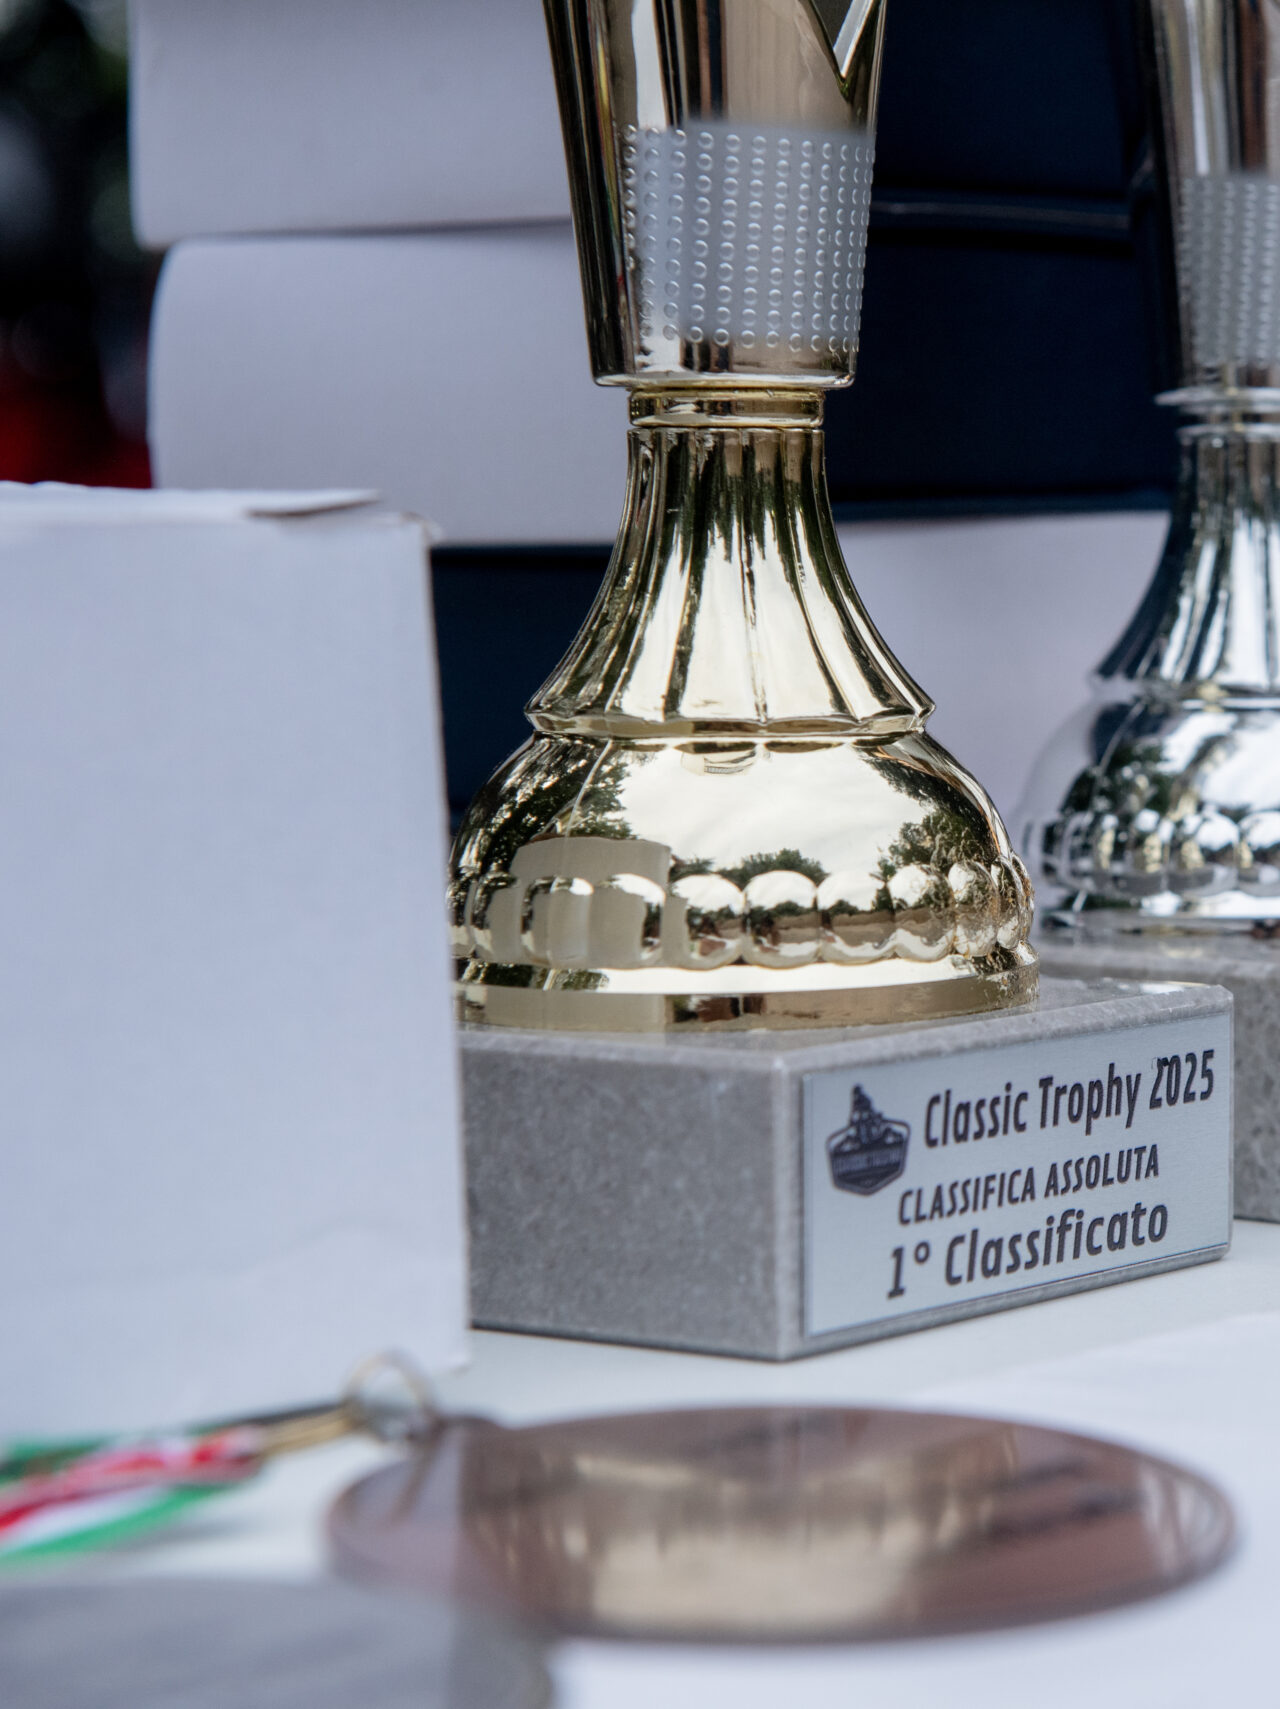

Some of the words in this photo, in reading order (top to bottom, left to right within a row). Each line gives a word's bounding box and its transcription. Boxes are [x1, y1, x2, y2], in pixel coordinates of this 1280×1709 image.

[925, 1082, 1028, 1149] Classic
[1038, 1062, 1142, 1136] Trophy
[1148, 1049, 1216, 1111] 2025
[898, 1166, 1036, 1226] CLASSIFICA
[1044, 1144, 1160, 1199] ASSOLUTA
[886, 1240, 931, 1300] 1°
[944, 1201, 1169, 1287] Classificato
